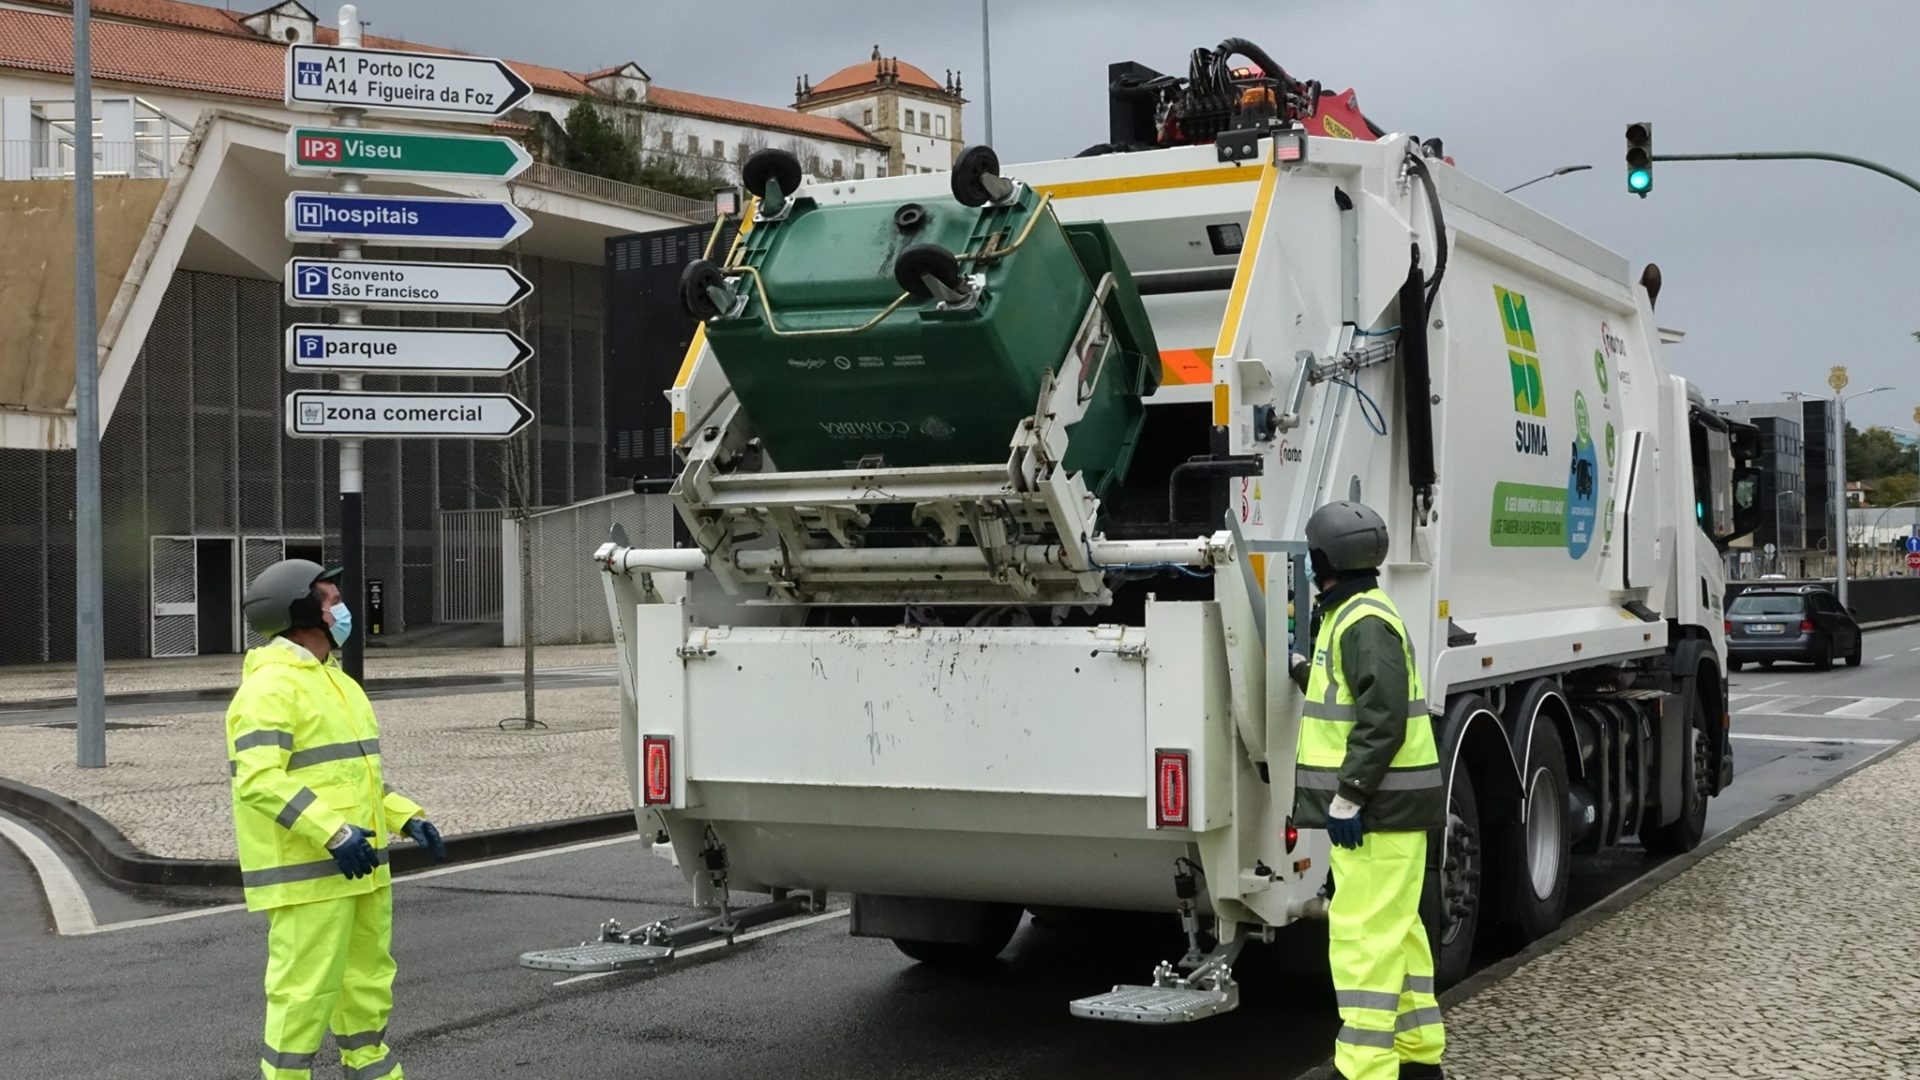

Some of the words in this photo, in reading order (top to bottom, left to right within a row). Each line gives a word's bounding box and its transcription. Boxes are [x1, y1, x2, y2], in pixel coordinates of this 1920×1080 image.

[325, 56, 346, 73] A1
[358, 58, 403, 78] Porto
[409, 62, 435, 80] IC2
[325, 78, 358, 96] A14
[367, 81, 435, 102] Figueira
[440, 86, 460, 104] da
[465, 88, 494, 105] Foz
[304, 139, 337, 158] IP3
[345, 139, 402, 159] Viseu
[302, 206, 318, 224] H
[324, 204, 419, 227] hospitais
[305, 272, 321, 293] P
[331, 266, 404, 282] Convento
[331, 282, 361, 296] São
[365, 284, 439, 299] Francisco
[306, 340, 318, 356] P
[326, 340, 398, 359] parque
[327, 406, 376, 421] zona
[383, 405, 482, 422] comercial
[819, 421, 910, 434] COIMBRA
[1515, 420, 1548, 457] SUMA
